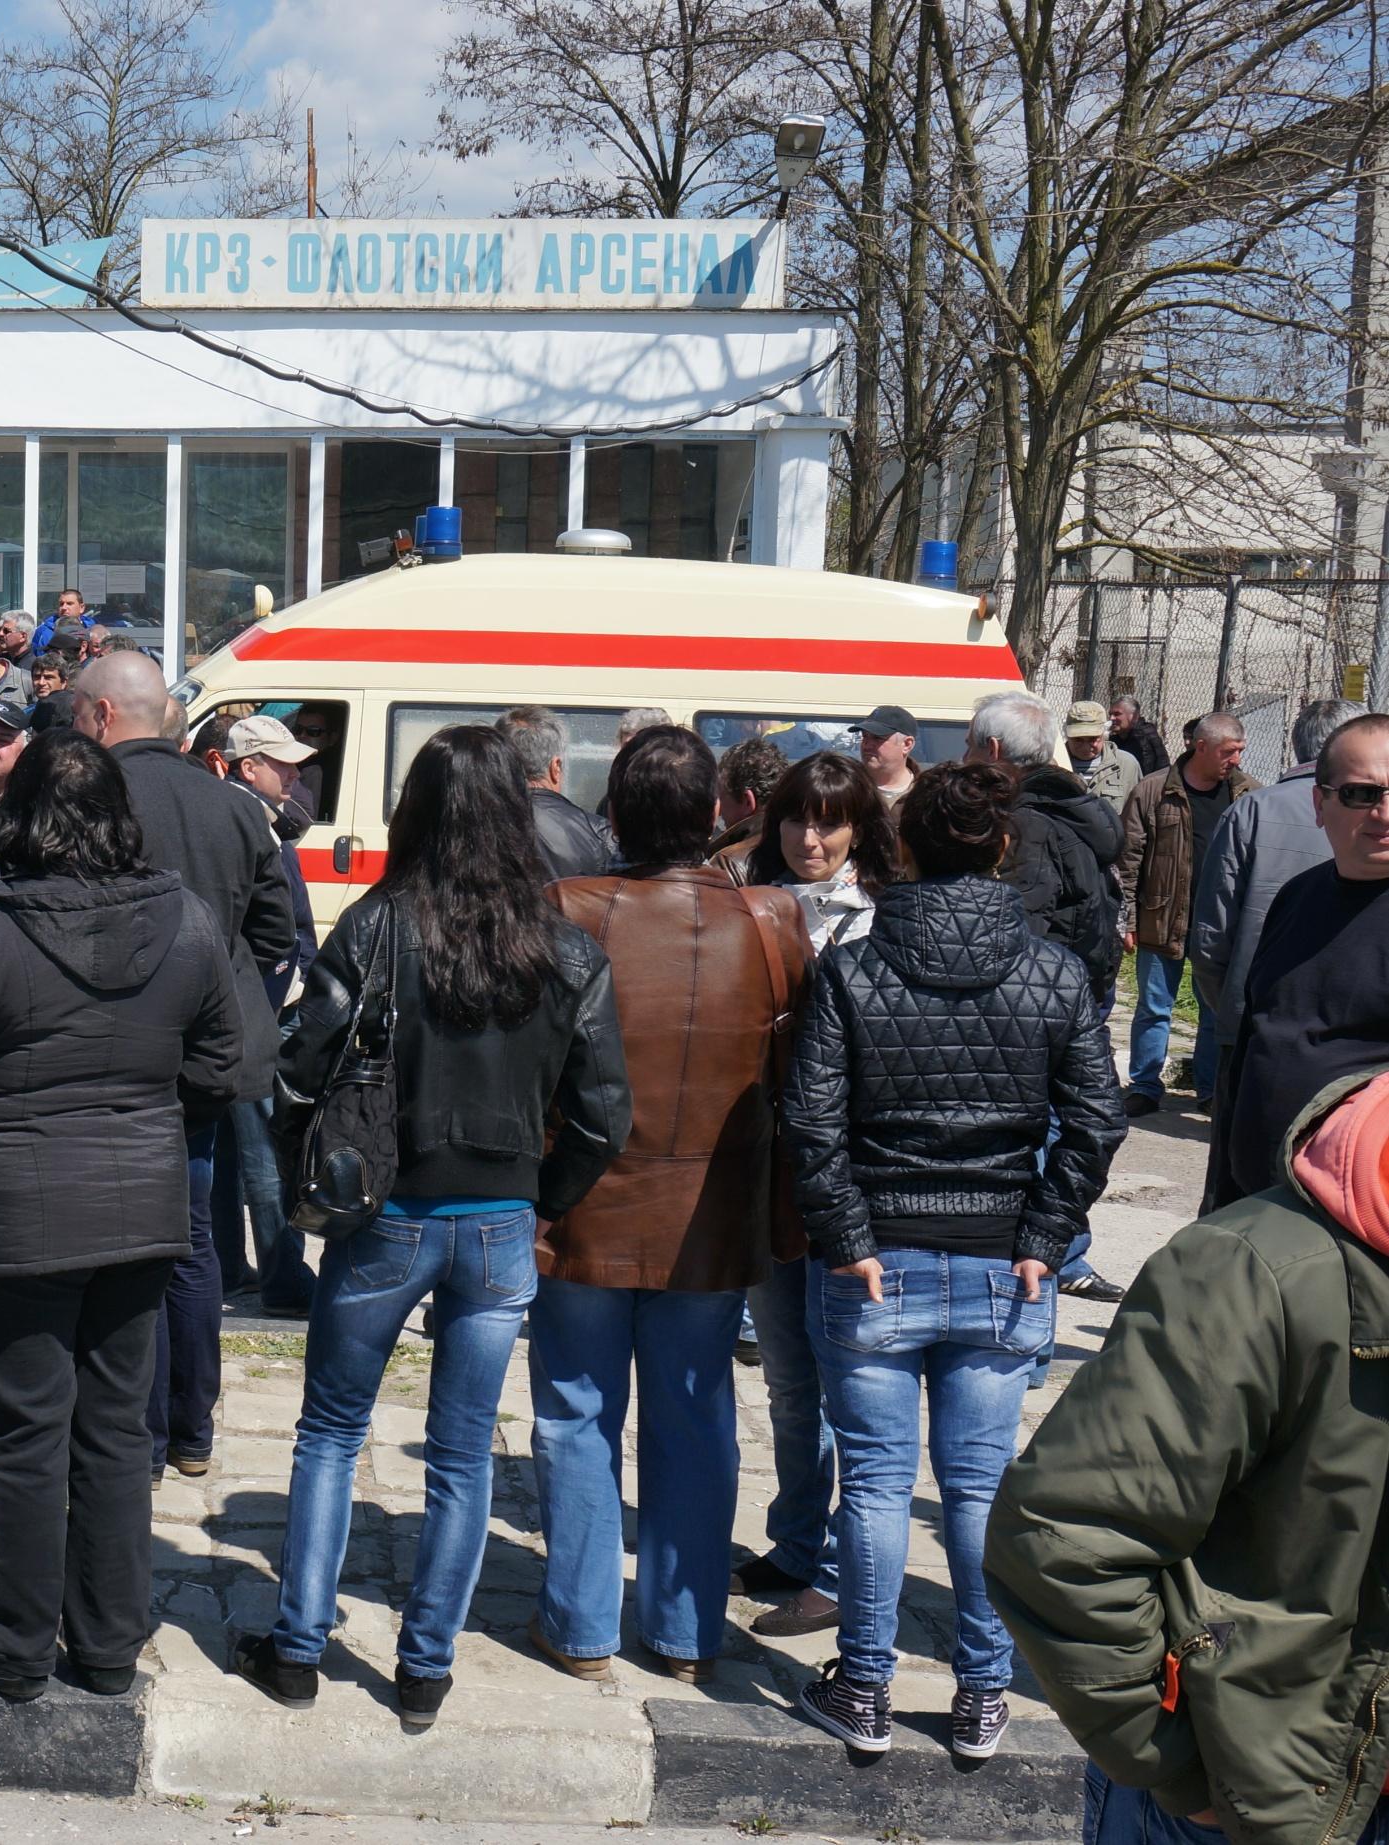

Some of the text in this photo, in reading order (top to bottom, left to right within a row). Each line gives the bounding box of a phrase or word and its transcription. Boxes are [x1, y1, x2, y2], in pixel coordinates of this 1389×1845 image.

[164, 232, 758, 295] КРЗ ФЛОТСКИ АРСЕНАЛ
